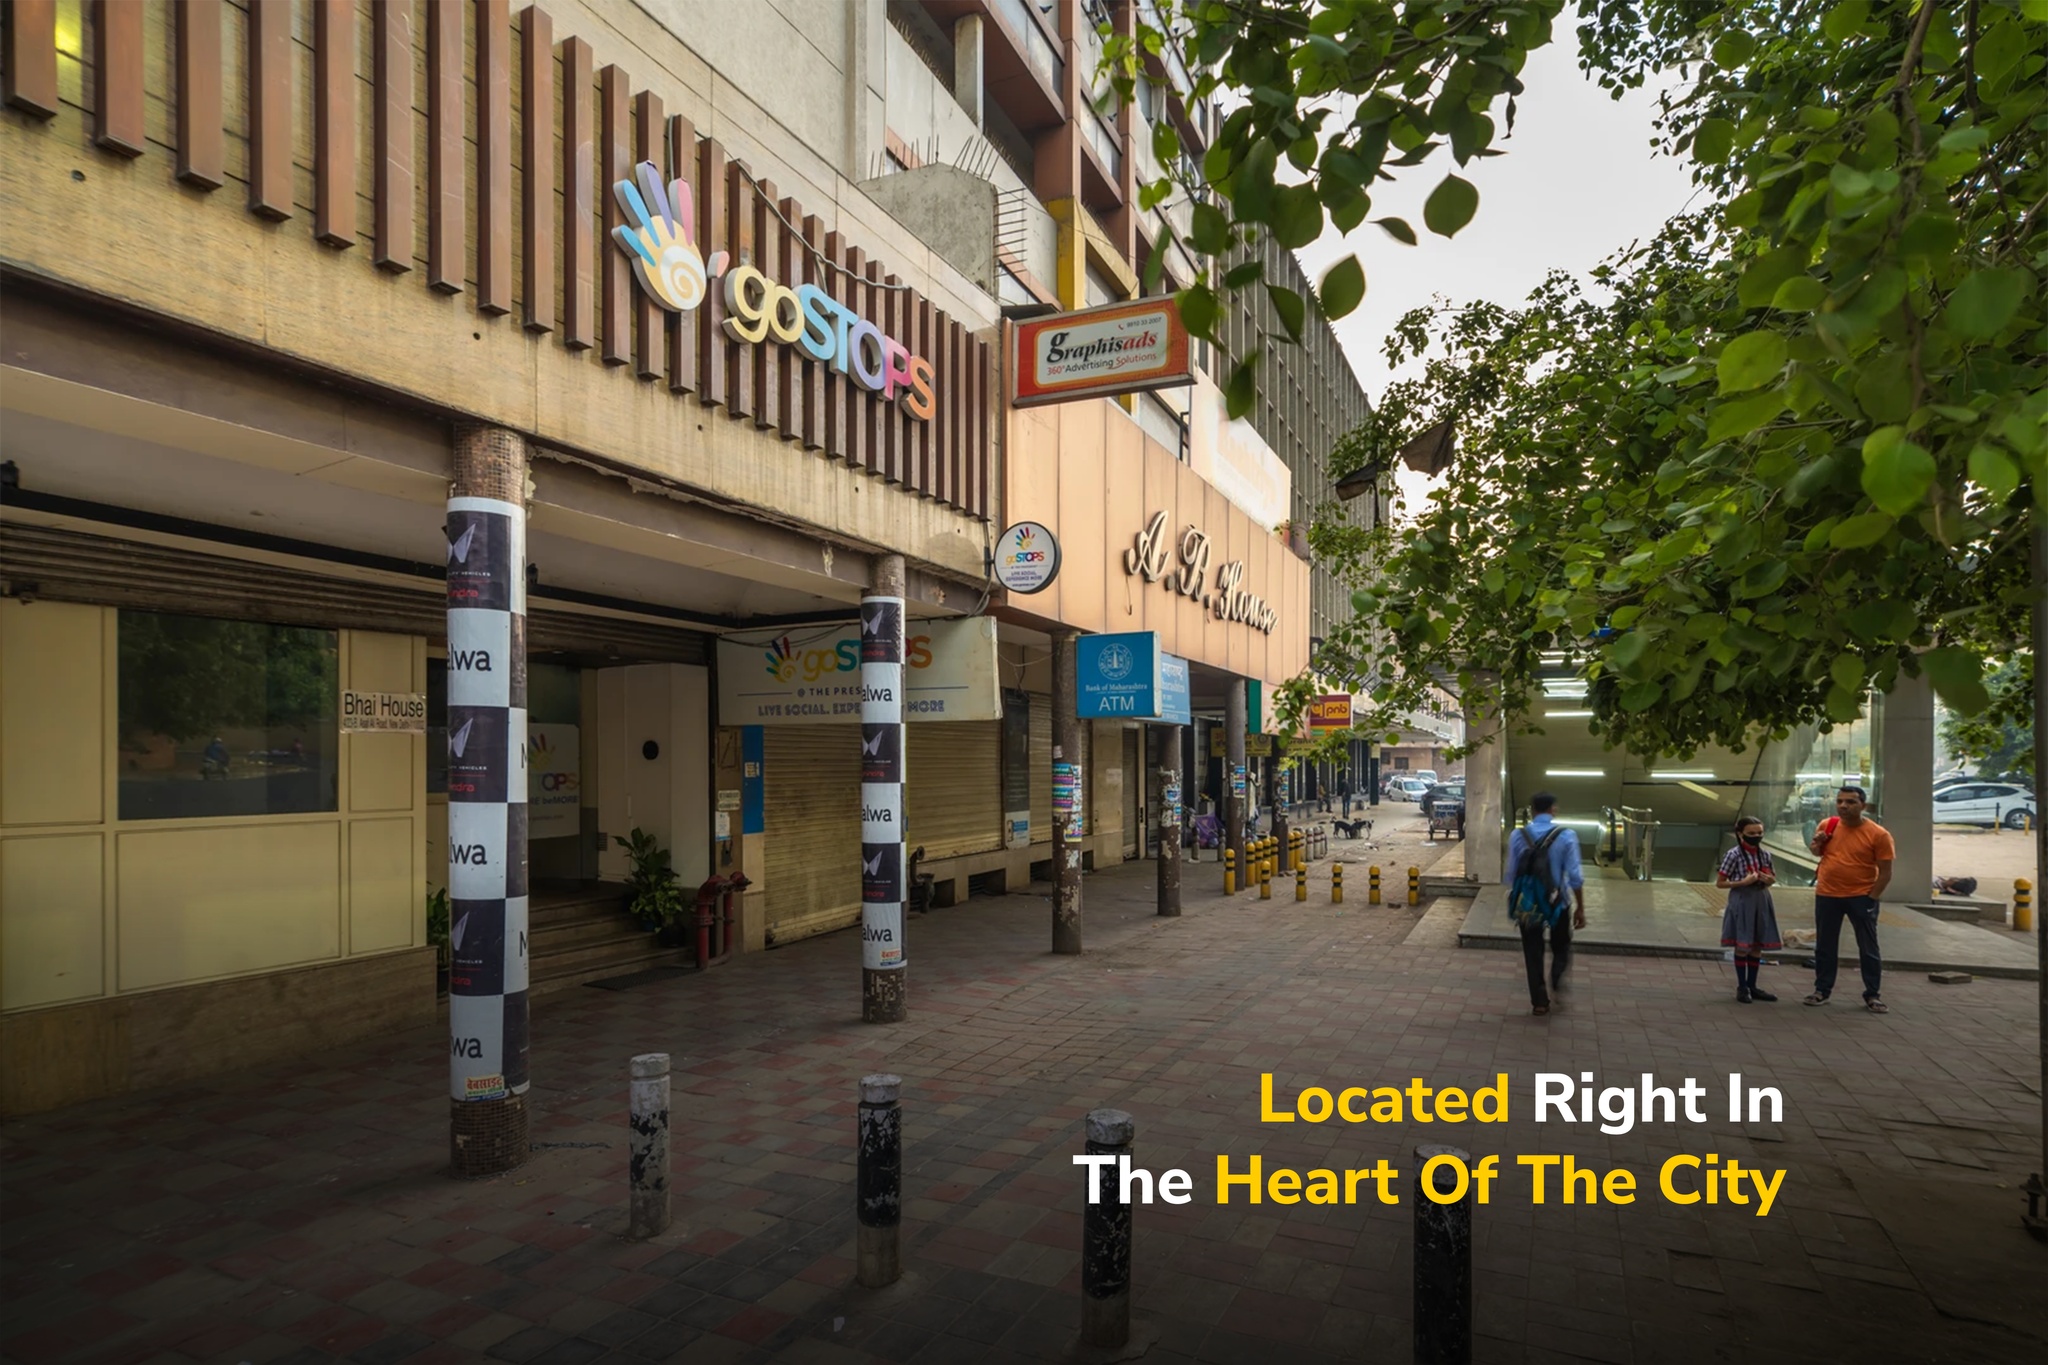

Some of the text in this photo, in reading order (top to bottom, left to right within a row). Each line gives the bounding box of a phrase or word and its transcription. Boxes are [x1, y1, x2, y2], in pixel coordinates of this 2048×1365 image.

[722, 265, 936, 421] goSTOPS
[1115, 353, 1157, 366] Solutions
[1006, 551, 1045, 566] goSTOPS
[809, 687, 830, 696] THE
[834, 686, 862, 696] PRES
[862, 684, 893, 702] alwa
[1085, 684, 1101, 692] Bank
[1109, 682, 1148, 691] Maharashtra
[344, 693, 424, 718] Bhai House
[758, 704, 782, 717] LIVE
[833, 702, 862, 715] EXPE
[907, 700, 945, 713] MORE
[1099, 696, 1135, 711] ATM
[1325, 702, 1348, 717] pnb
[862, 805, 892, 823] alwa
[862, 925, 893, 943] alwa
